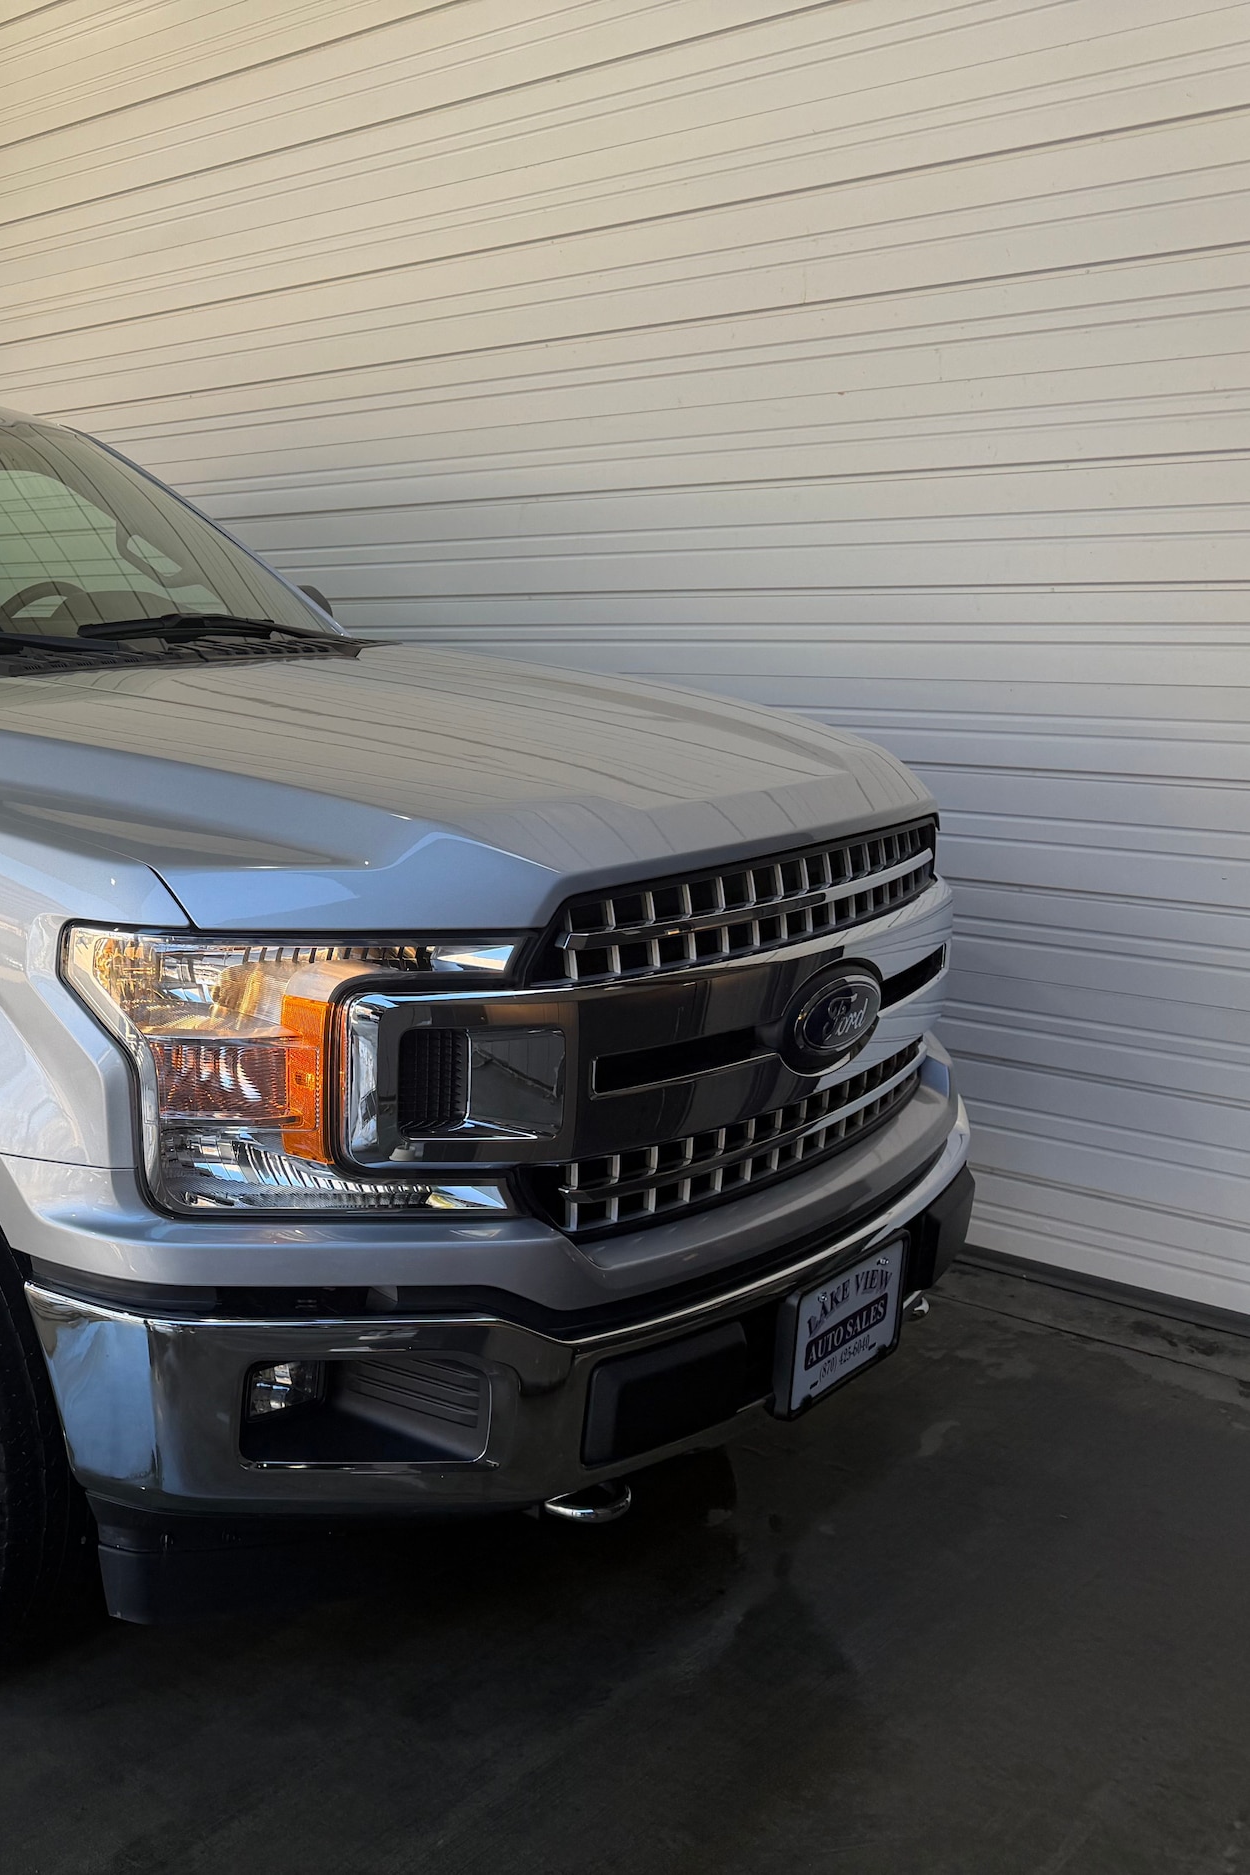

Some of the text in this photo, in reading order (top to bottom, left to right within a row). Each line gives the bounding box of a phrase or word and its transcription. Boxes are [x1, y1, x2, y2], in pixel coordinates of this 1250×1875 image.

[823, 993, 868, 1041] Ford
[807, 1269, 892, 1337] LAKE VIEW
[807, 1301, 885, 1366] AUTO SALES
[819, 1357, 837, 1383] (870)
